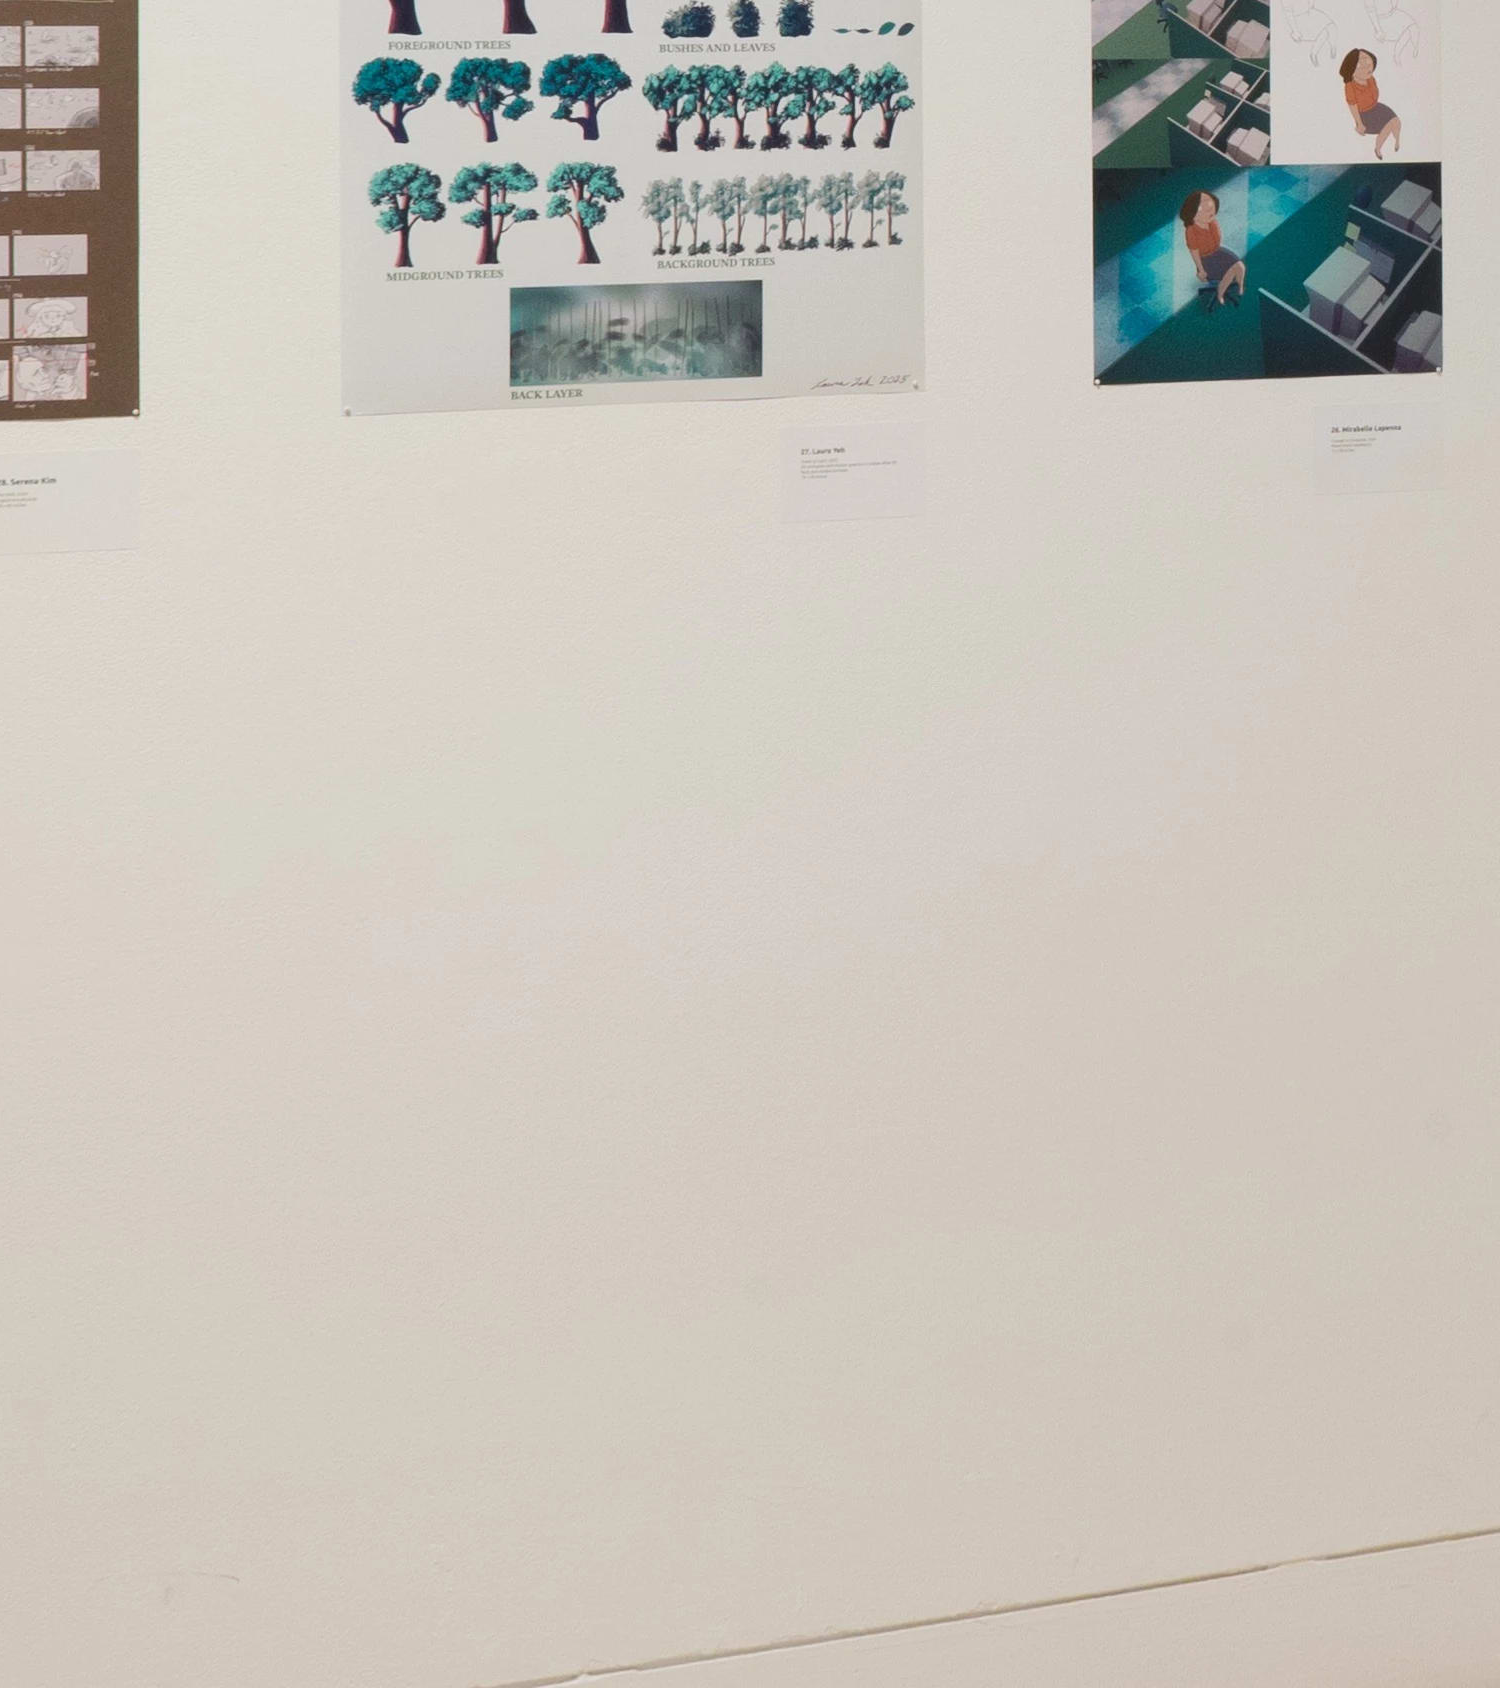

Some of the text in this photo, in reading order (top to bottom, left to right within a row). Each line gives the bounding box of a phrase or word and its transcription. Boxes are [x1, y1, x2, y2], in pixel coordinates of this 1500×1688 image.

[388, 40, 511, 51] FOREGROUND TREES
[659, 43, 776, 53] BUSHES AND LEAVES
[657, 257, 776, 270] BACKGROUND TREES
[386, 269, 504, 282] MIDGROUND TREES
[879, 374, 911, 385] 2025
[511, 389, 583, 401] BACK LAYER
[41, 477, 57, 485] Kim
